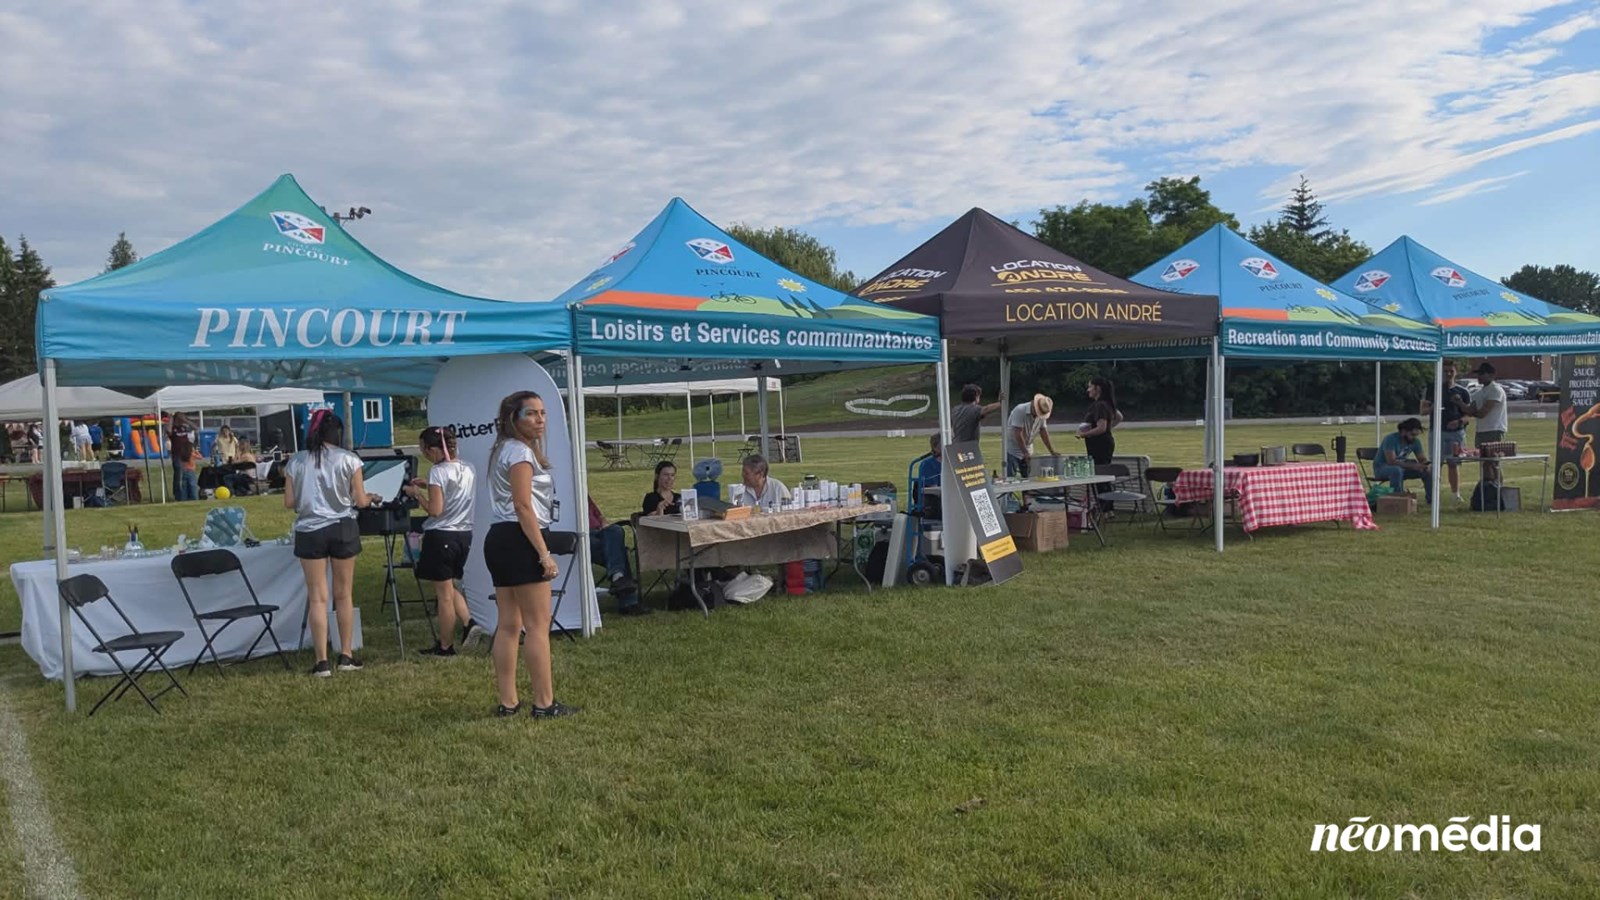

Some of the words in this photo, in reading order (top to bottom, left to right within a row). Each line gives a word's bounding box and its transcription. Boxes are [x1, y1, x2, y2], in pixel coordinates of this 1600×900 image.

[263, 243, 350, 266] PINCOURT
[696, 268, 762, 279] PINCOURT
[988, 259, 1082, 273] LOCATION
[1005, 302, 1098, 323] LOCATION
[1104, 301, 1163, 323] ANDRÉ
[189, 307, 468, 348] PINCOURT
[591, 318, 665, 342] Loisirs
[671, 322, 692, 343] et
[697, 322, 781, 346] Services
[786, 330, 934, 350] communautaires
[1228, 328, 1297, 347] Recreation
[1300, 331, 1323, 347] and
[1326, 331, 1389, 352] Community
[1392, 335, 1437, 352] Services
[1447, 332, 1481, 348] Loisirs
[1483, 333, 1493, 347] et
[1496, 332, 1536, 347] Services
[1538, 330, 1600, 346] communautai
